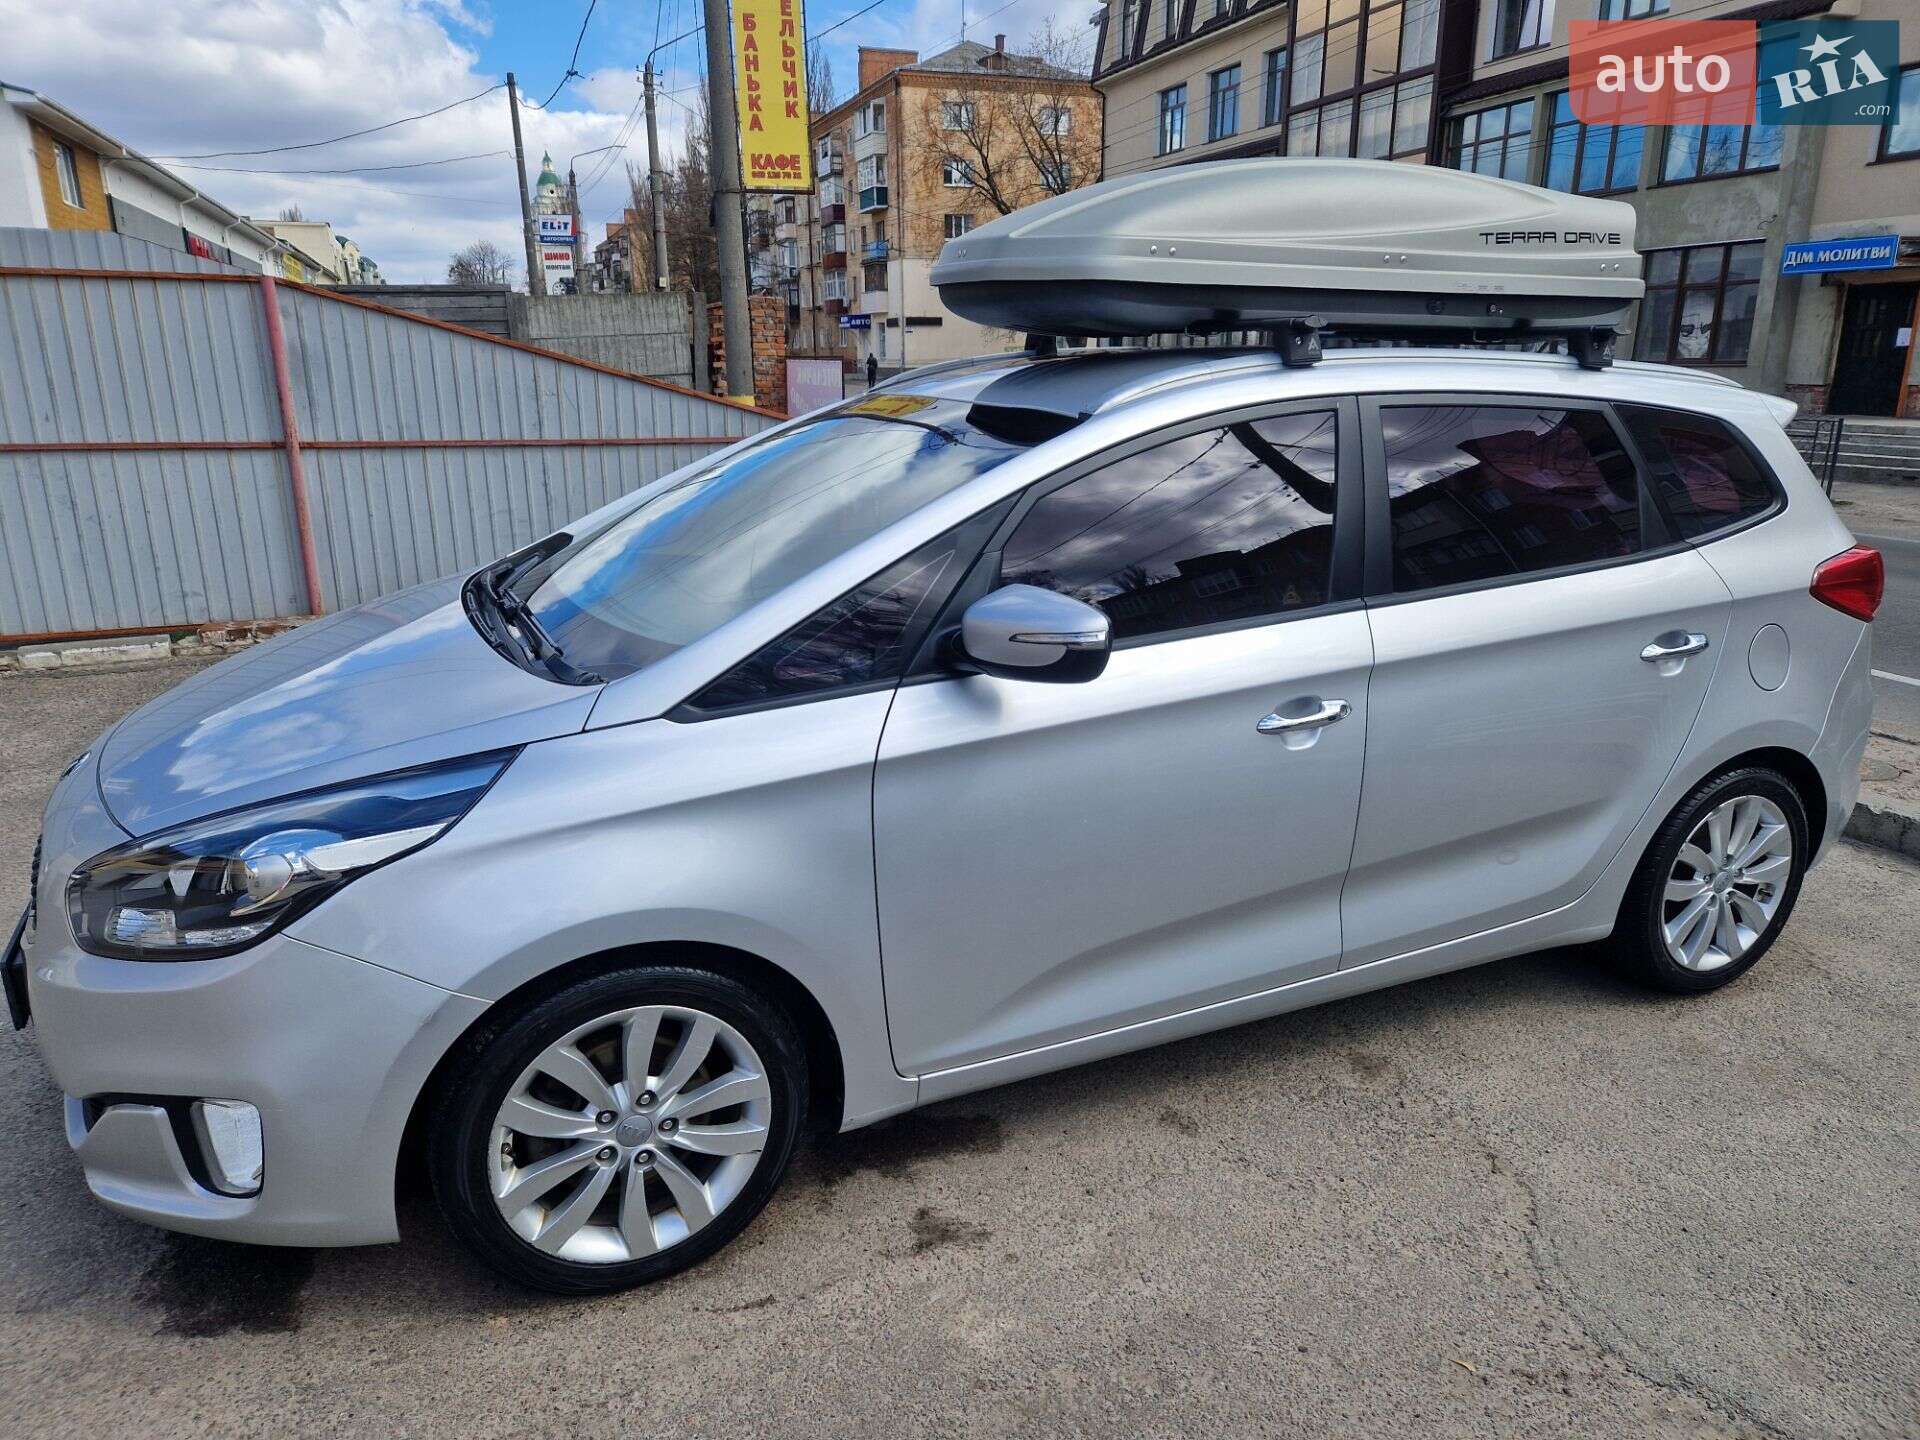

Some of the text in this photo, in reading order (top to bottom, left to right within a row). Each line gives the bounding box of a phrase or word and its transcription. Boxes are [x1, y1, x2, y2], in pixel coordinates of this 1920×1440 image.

[742, 12, 764, 132] БАНЬКА
[750, 153, 801, 171] КАФЕ
[1479, 231, 1621, 245] TERRA DRIVE
[544, 252, 570, 261] ШИНО
[1817, 245, 1892, 263] МОЛИТВИ
